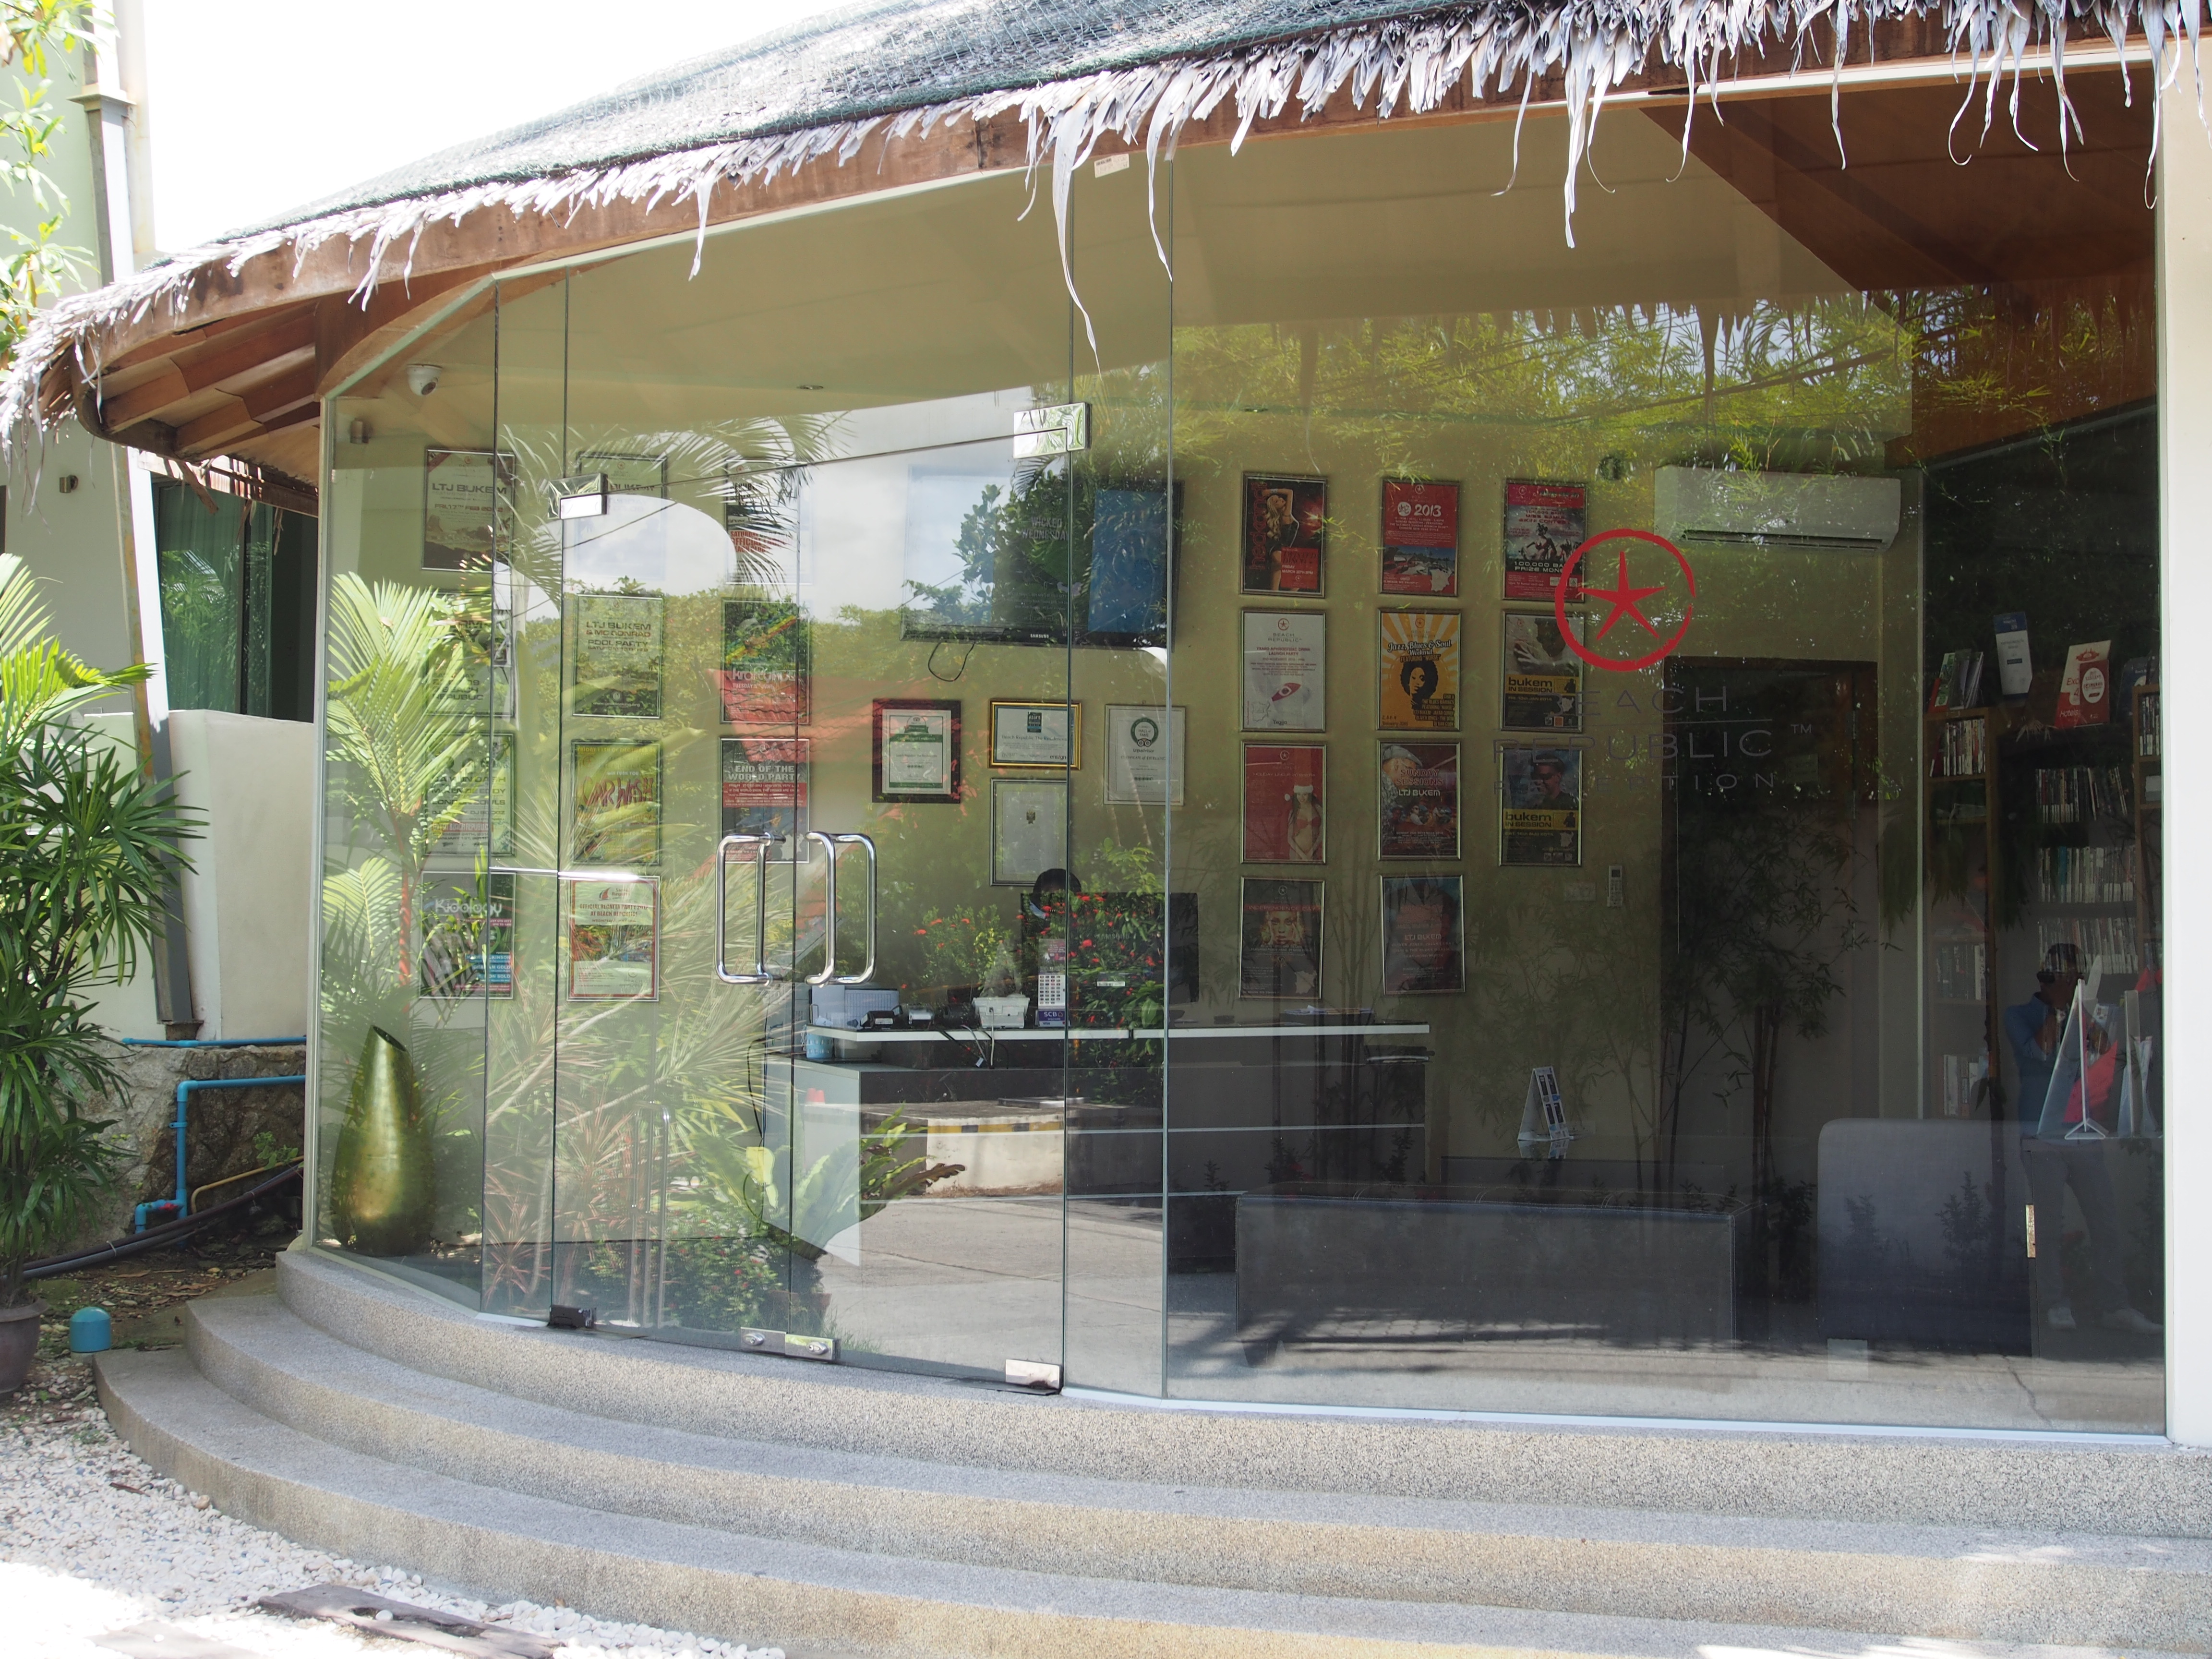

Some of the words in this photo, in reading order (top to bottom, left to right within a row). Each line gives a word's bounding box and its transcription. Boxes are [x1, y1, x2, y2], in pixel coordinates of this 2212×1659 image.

[432, 482, 454, 491] LTJ
[457, 484, 507, 494] BUKEM
[1414, 504, 1442, 517] 2013
[1031, 517, 1062, 528] WICKED
[607, 622, 651, 630] BUKEM
[1388, 642, 1407, 652] Jazz,
[1407, 641, 1427, 649] Blues
[1434, 639, 1452, 648] Soul
[1409, 648, 1433, 656] Weekend
[1508, 677, 1552, 687] bukem
[1493, 730, 1772, 764] REPUBLIC
[1395, 778, 1444, 786] SESSIONS
[581, 776, 615, 807] CAR
[616, 777, 654, 810] WASH
[1505, 812, 1551, 821] bukem
